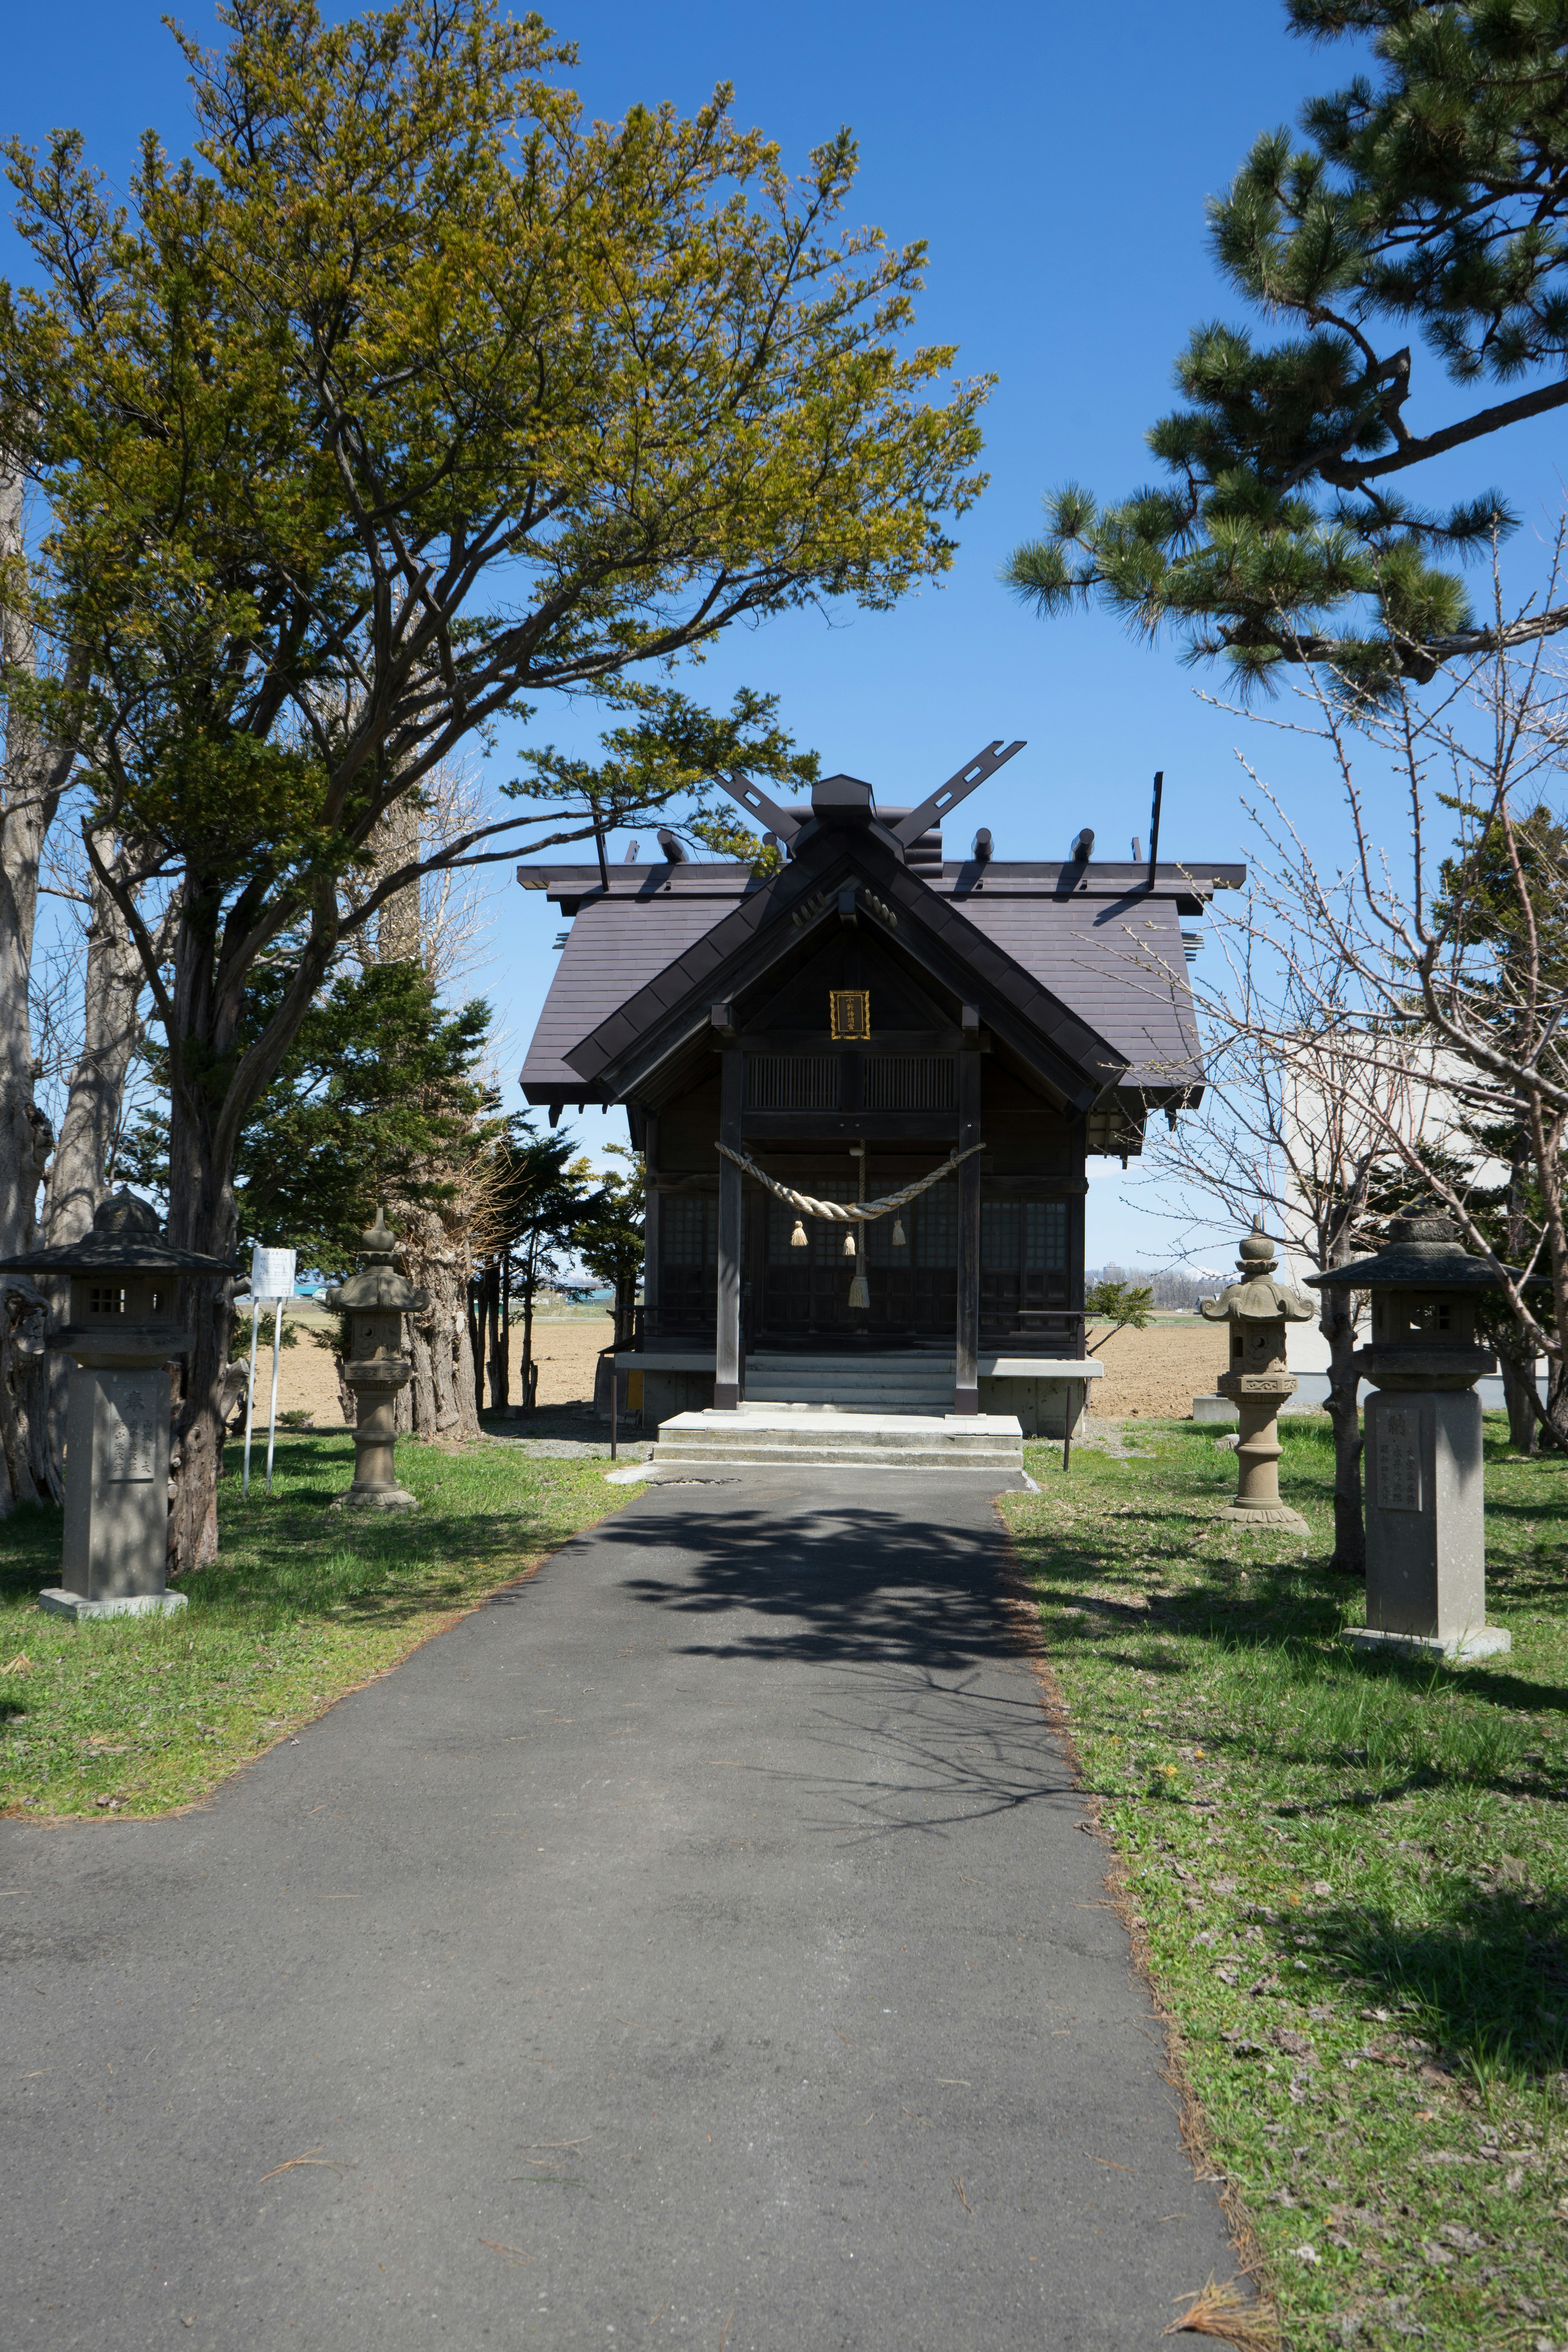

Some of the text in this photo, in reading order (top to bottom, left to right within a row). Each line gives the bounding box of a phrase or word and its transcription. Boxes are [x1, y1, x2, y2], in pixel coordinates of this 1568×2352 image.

[124, 1390, 146, 1412] 奉
[1387, 1414, 1406, 1436] 納
[1379, 1444, 1389, 1504] 昭和四年九月
